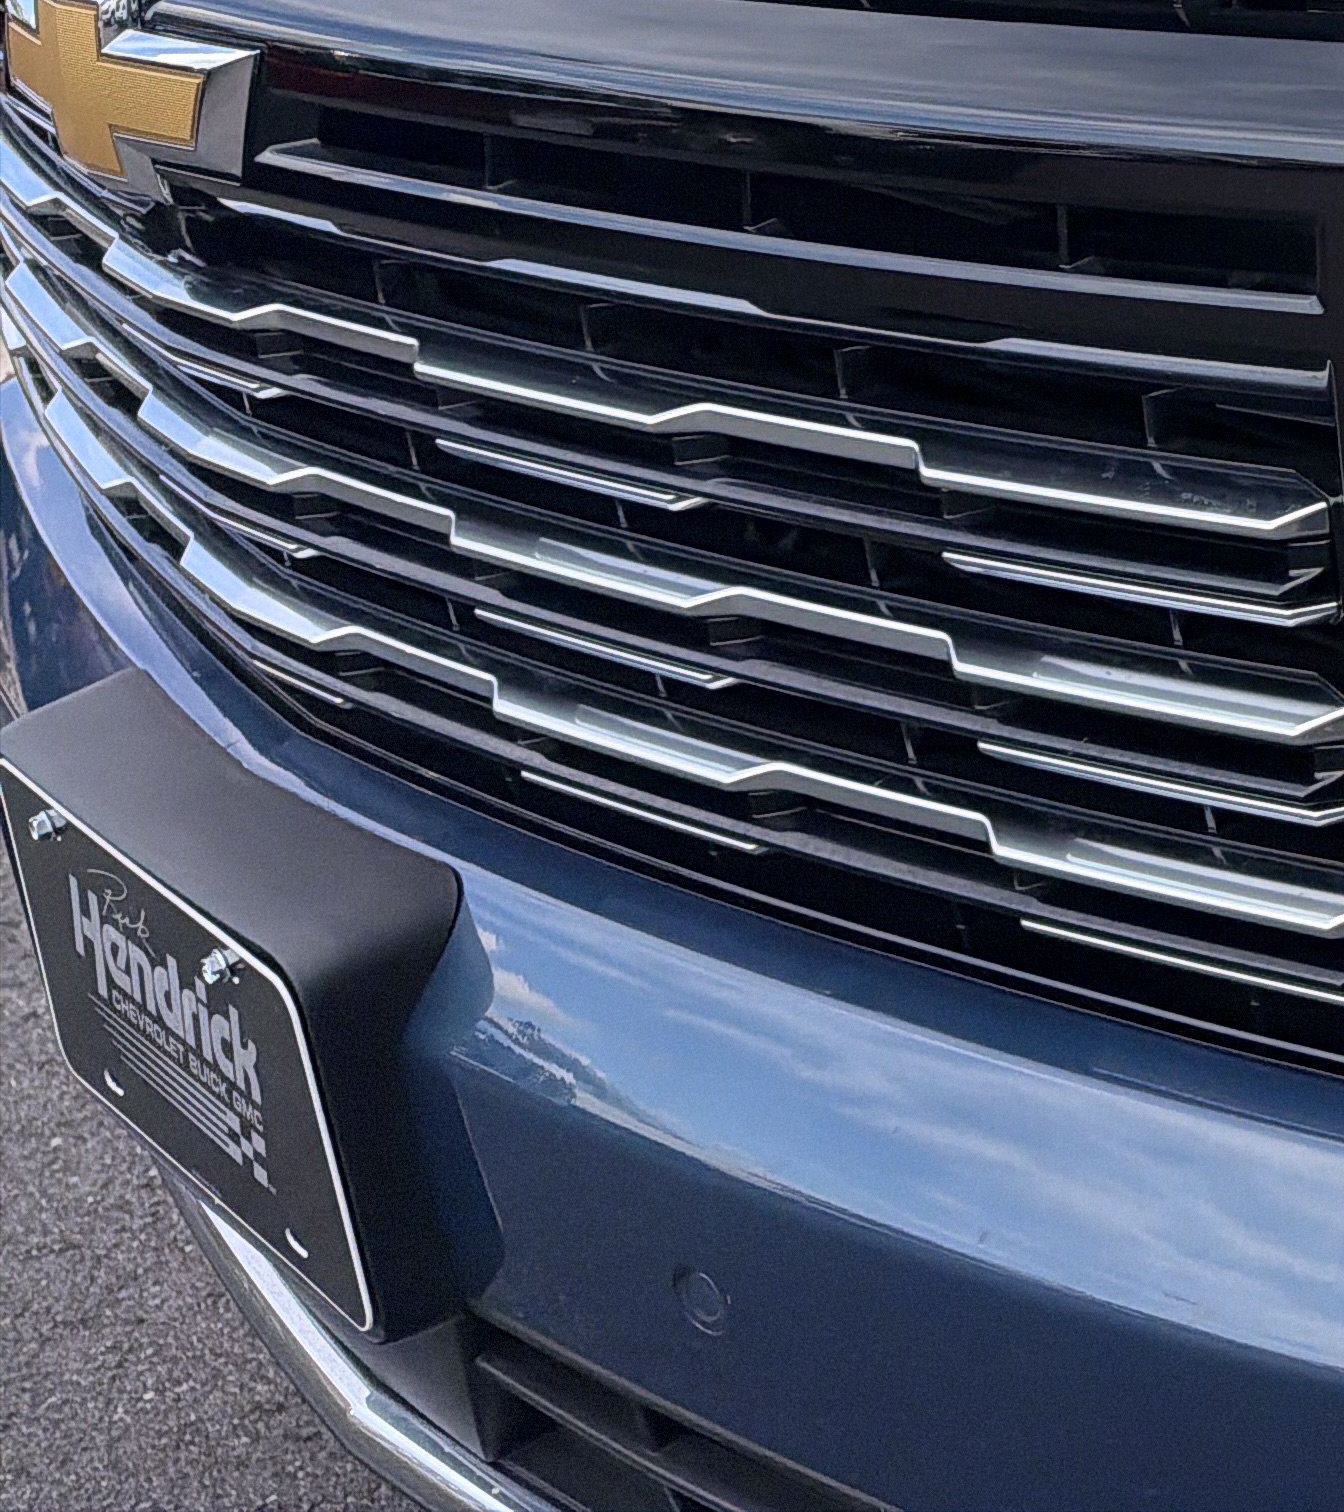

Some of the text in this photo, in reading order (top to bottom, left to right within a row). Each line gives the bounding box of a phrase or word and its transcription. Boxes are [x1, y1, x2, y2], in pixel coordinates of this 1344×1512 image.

[69, 874, 261, 1106] Hendrick
[111, 989, 264, 1133] CHEVROLET BUICK GMC
